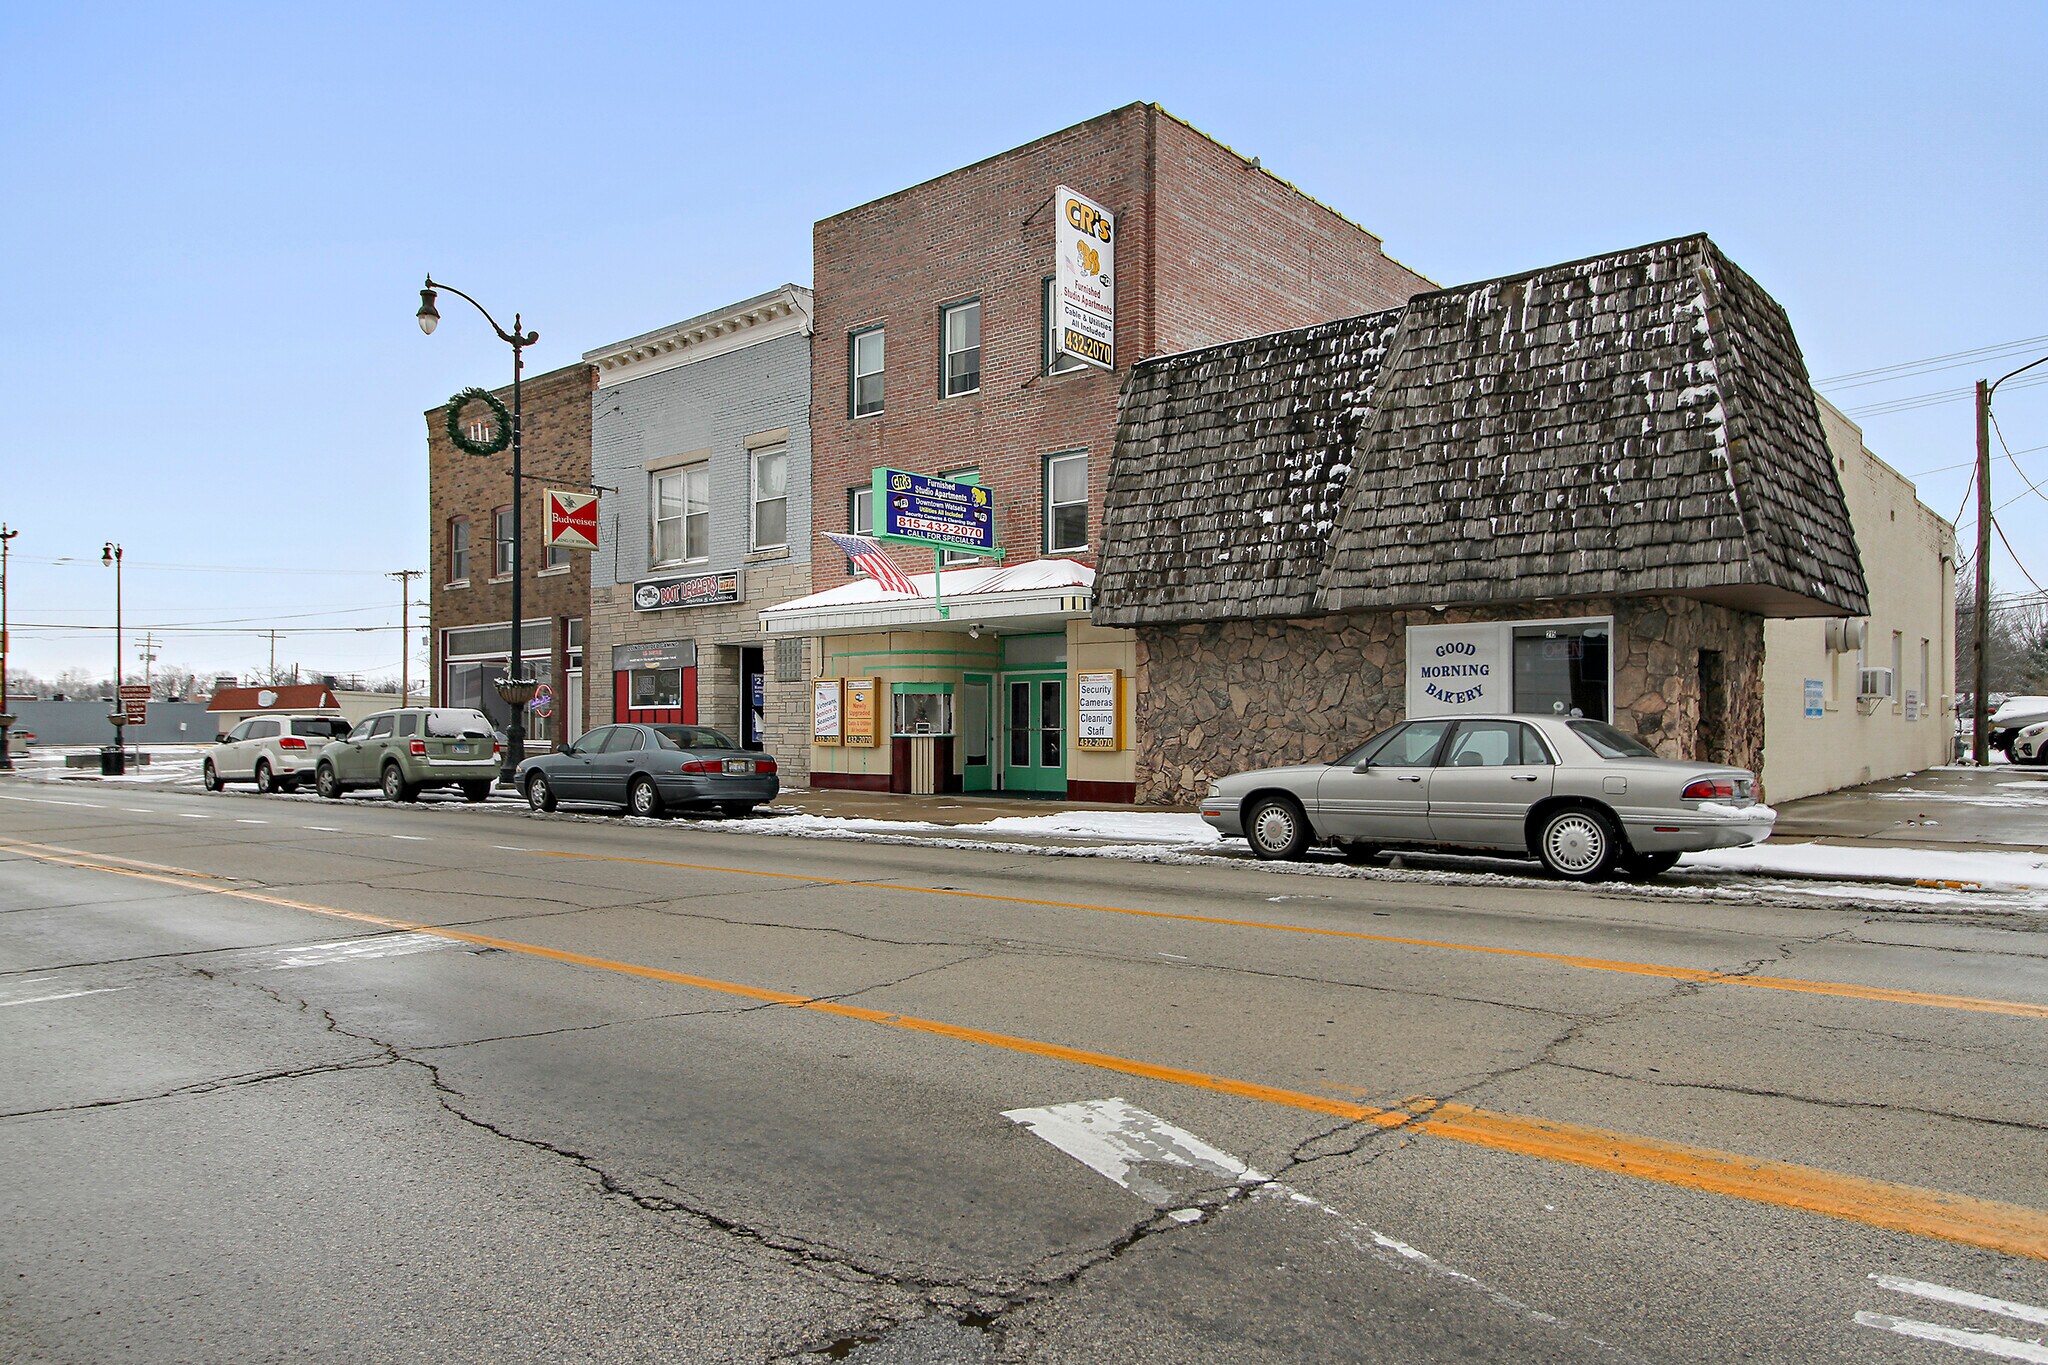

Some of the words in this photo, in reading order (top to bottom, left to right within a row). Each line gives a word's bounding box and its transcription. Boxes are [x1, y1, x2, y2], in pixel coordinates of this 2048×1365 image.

[1065, 198, 1111, 243] CR's
[1074, 279, 1101, 299] Furnished
[1063, 286, 1081, 302] Studio
[1081, 295, 1112, 315] Apartments
[1064, 306, 1081, 319] Cable
[1082, 314, 1088, 322] &
[1088, 316, 1112, 332] Utilities
[1071, 319, 1080, 328] All
[1081, 322, 1105, 339] Included
[1065, 330, 1111, 364] 432-2070
[891, 474, 912, 490] CR's
[927, 478, 956, 491] Furnished
[914, 485, 934, 496] Studio
[934, 489, 967, 502] Apartments
[915, 497, 945, 509] Downtown
[944, 502, 967, 512] Watseka
[919, 506, 938, 515] Utilities
[945, 510, 964, 518] Included
[552, 512, 596, 526] Budweiser
[905, 511, 923, 519] Security
[923, 513, 943, 521] Cameras
[947, 517, 966, 526] Cleaning
[898, 517, 982, 538] 815-432-2070
[907, 529, 926, 539] CALL
[926, 532, 941, 540] FOR
[942, 534, 975, 545] SPECIALS
[660, 583, 680, 605] BOOT
[680, 575, 717, 600] LEGGERS
[1435, 642, 1476, 657] GOOD
[1544, 642, 1581, 658] OPEN
[1421, 664, 1489, 678] MORNING
[1081, 685, 1112, 695] Security
[1425, 683, 1484, 704] BAKERY
[817, 699, 837, 710] Veterans
[1080, 698, 1113, 707] Cameras
[816, 707, 832, 718] Seniors
[817, 712, 837, 726] Seasonal
[1080, 713, 1112, 725] Cleaning
[816, 721, 838, 733] Discounts
[1087, 726, 1105, 736] Staff
[1079, 738, 1112, 747] 432-2070
